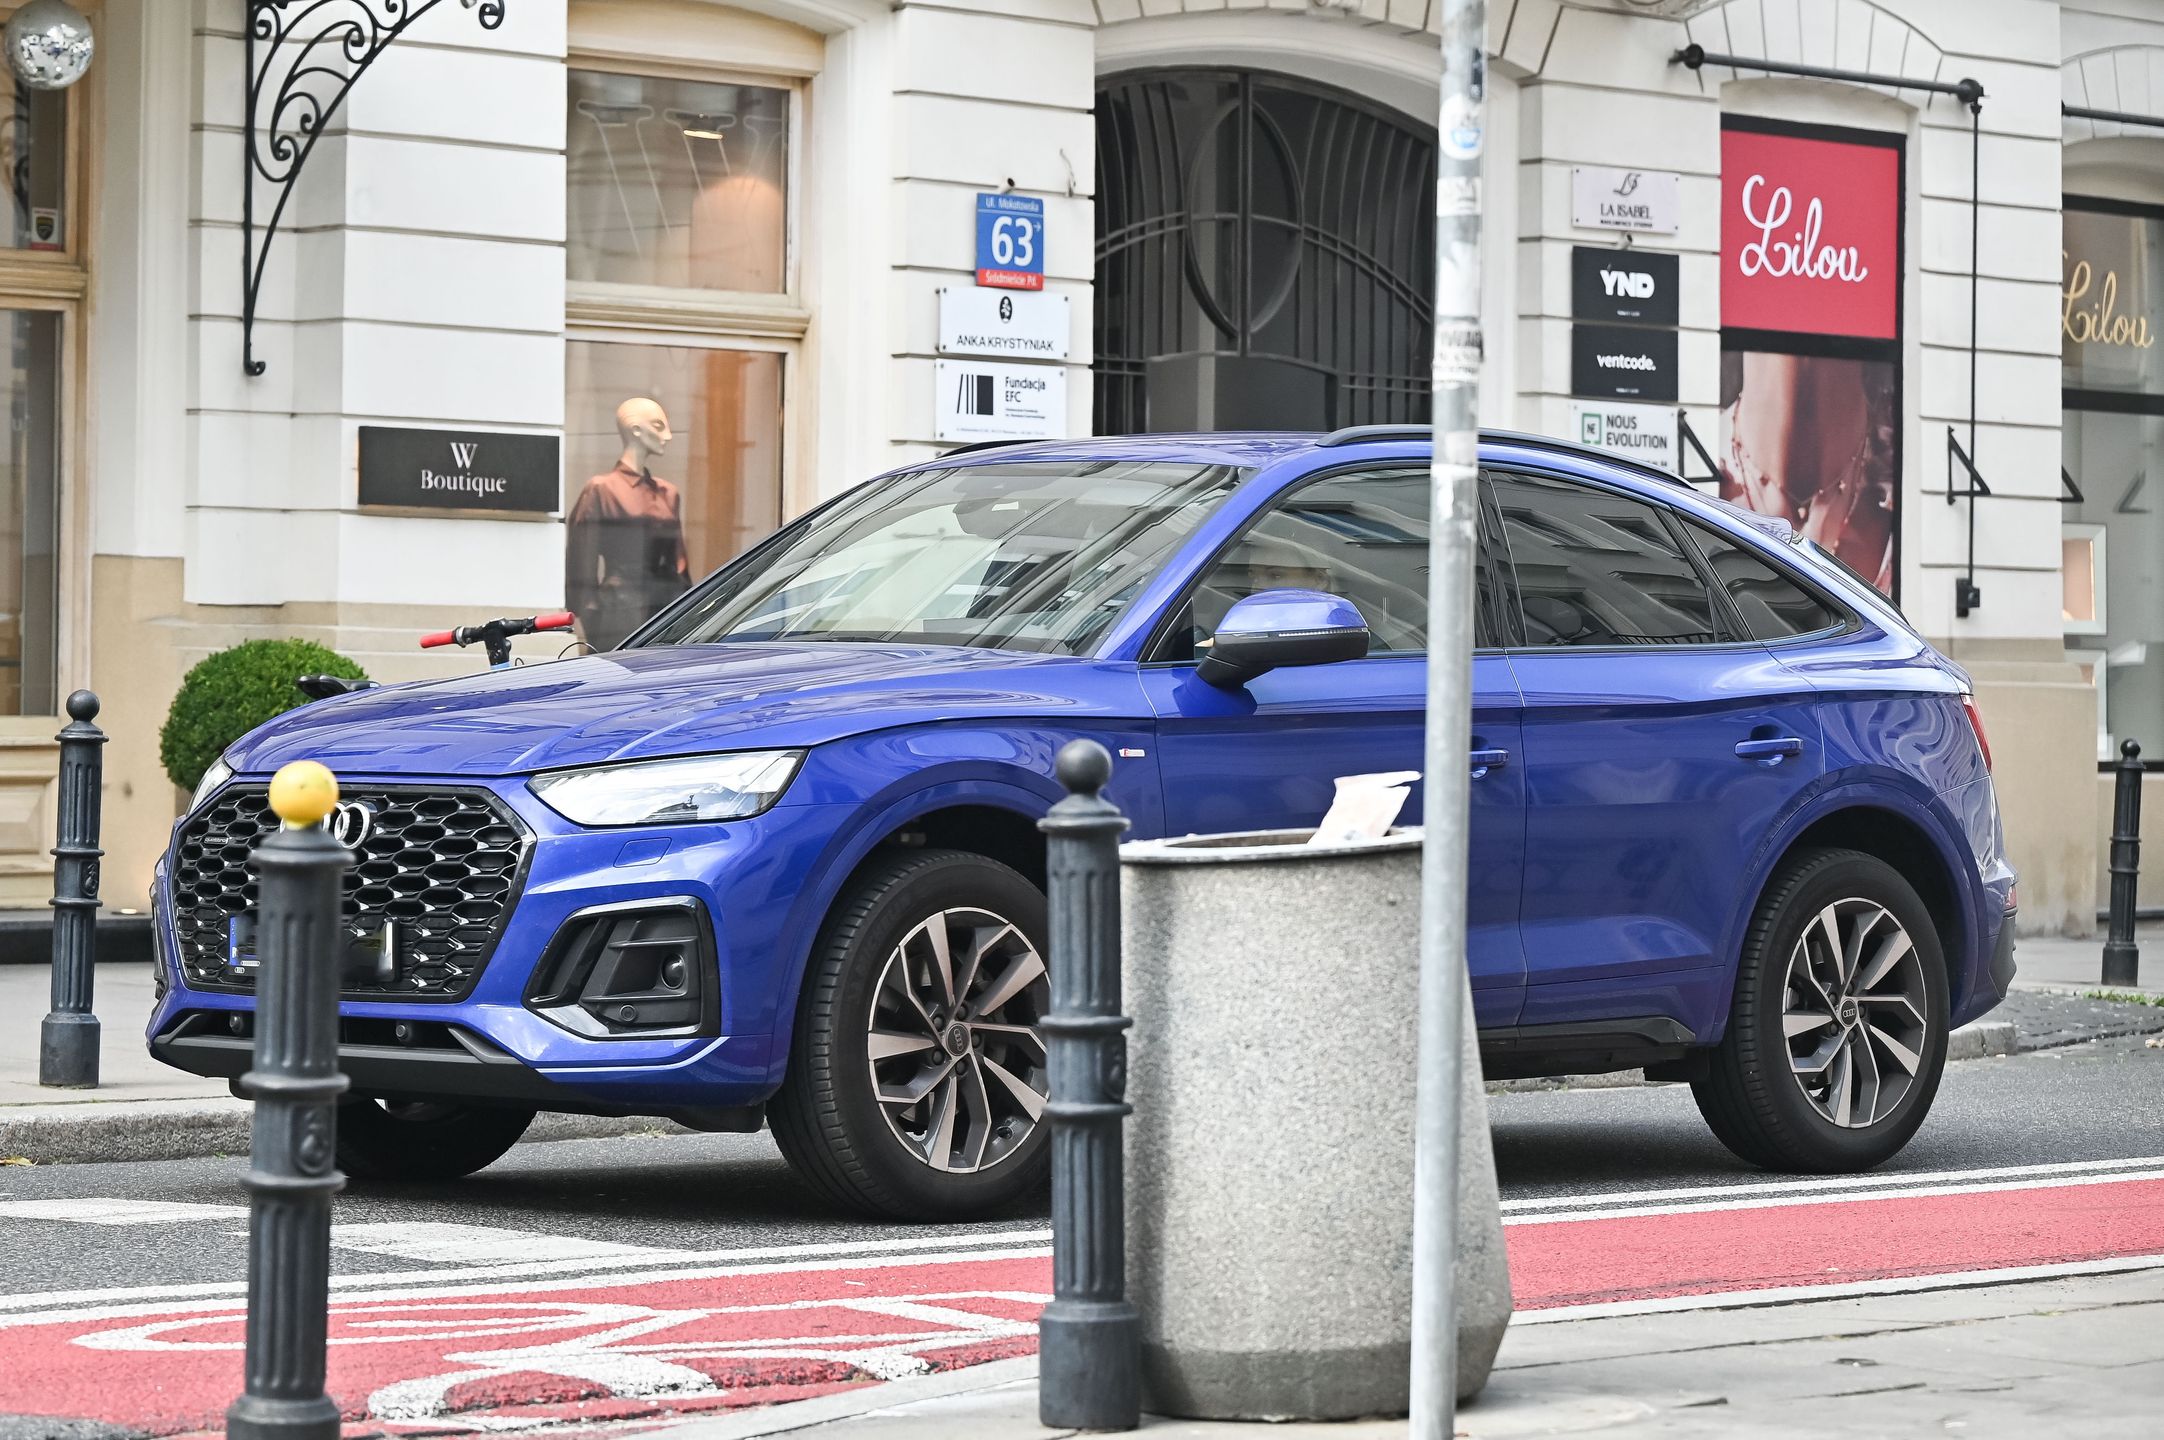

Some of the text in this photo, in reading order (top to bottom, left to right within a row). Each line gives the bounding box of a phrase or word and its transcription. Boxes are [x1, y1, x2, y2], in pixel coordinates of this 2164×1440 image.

[1600, 202, 1653, 220] LA ISABEL
[1739, 174, 1869, 283] Lilou
[991, 215, 1034, 267] 63
[1599, 269, 1655, 299] YND
[2061, 249, 2154, 348] Lilou
[956, 334, 1054, 351] ANKA KRYSTYNIAK
[1596, 353, 1657, 371] ventcode.
[1005, 376, 1046, 392] Fundacja
[1005, 390, 1021, 403] EFC
[1606, 415, 1637, 430] NOUS
[1606, 432, 1667, 449] EVOLUTION
[450, 442, 478, 469] W
[421, 469, 507, 498] Boutique
